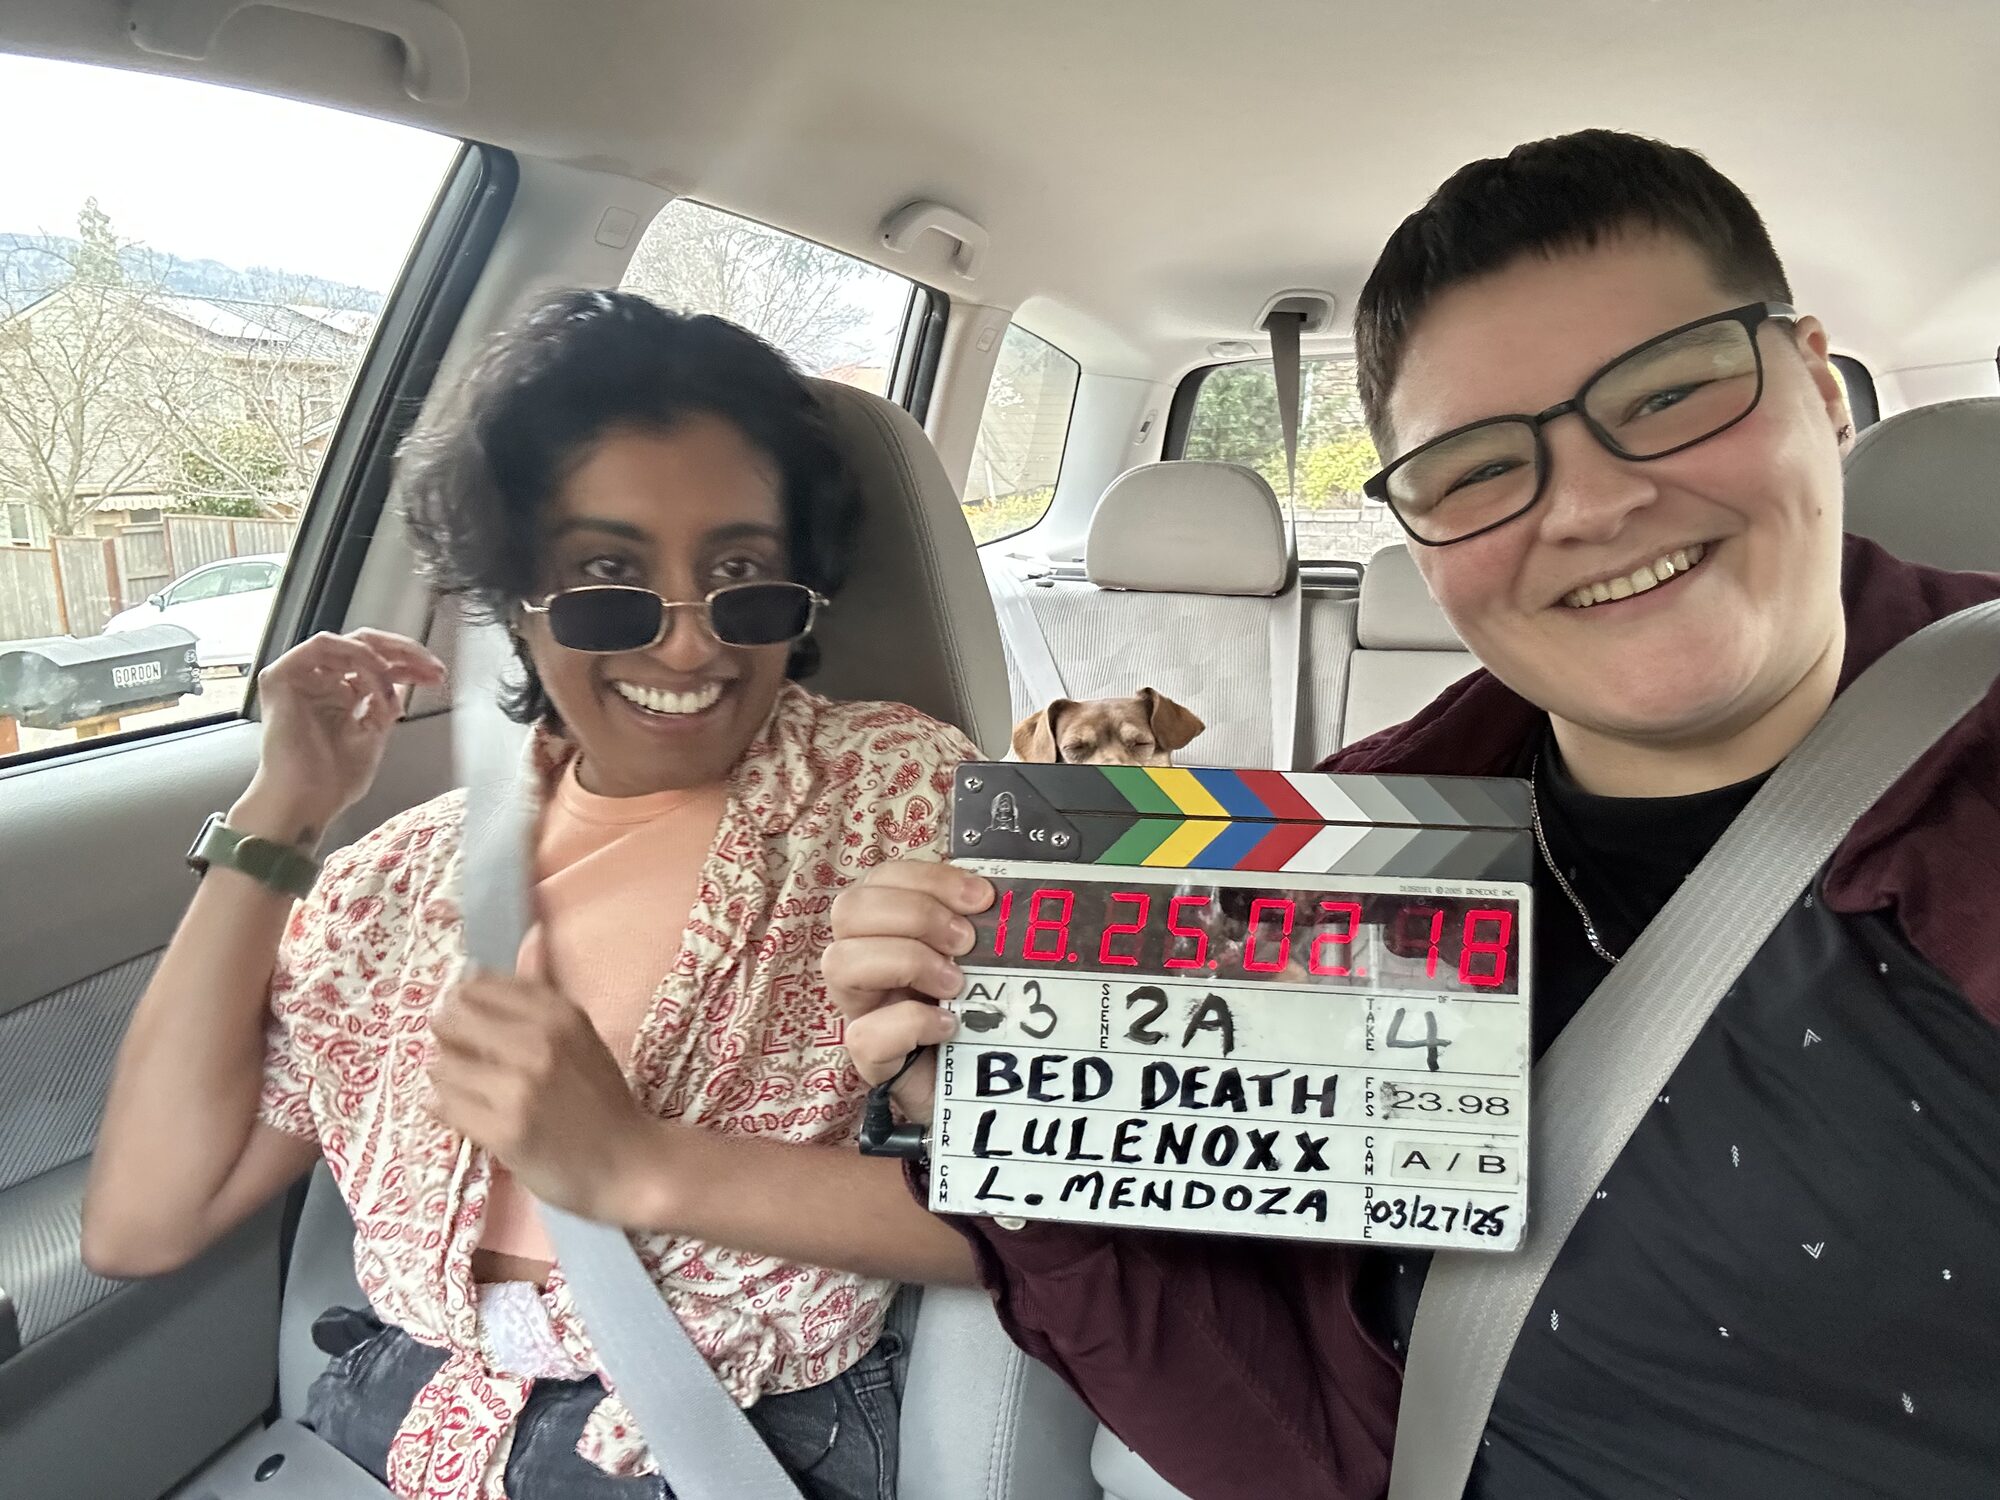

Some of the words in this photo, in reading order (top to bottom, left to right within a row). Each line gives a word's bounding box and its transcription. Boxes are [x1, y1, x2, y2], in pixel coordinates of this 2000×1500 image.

[115, 664, 159, 684] GORDON
[1019, 980, 1058, 1039] 3
[1100, 983, 1110, 1049] SCENE
[1366, 998, 1375, 1051] TAKE
[1386, 1007, 1452, 1071] 4
[944, 1045, 954, 1096] PROD
[975, 1051, 1113, 1103] BED
[1140, 1061, 1339, 1117] DEATH
[1365, 1077, 1375, 1117] FPS
[1390, 1090, 1510, 1116] 23.98
[941, 1108, 951, 1147] DIR
[972, 1109, 1330, 1171] LULENOXX
[1364, 1136, 1375, 1176] CAM
[939, 1165, 949, 1203] CAM
[974, 1165, 1045, 1206] L.
[1058, 1170, 1329, 1223] MENDOZA
[1363, 1186, 1374, 1239] DATE
[1370, 1194, 1510, 1237] 03/27/25
